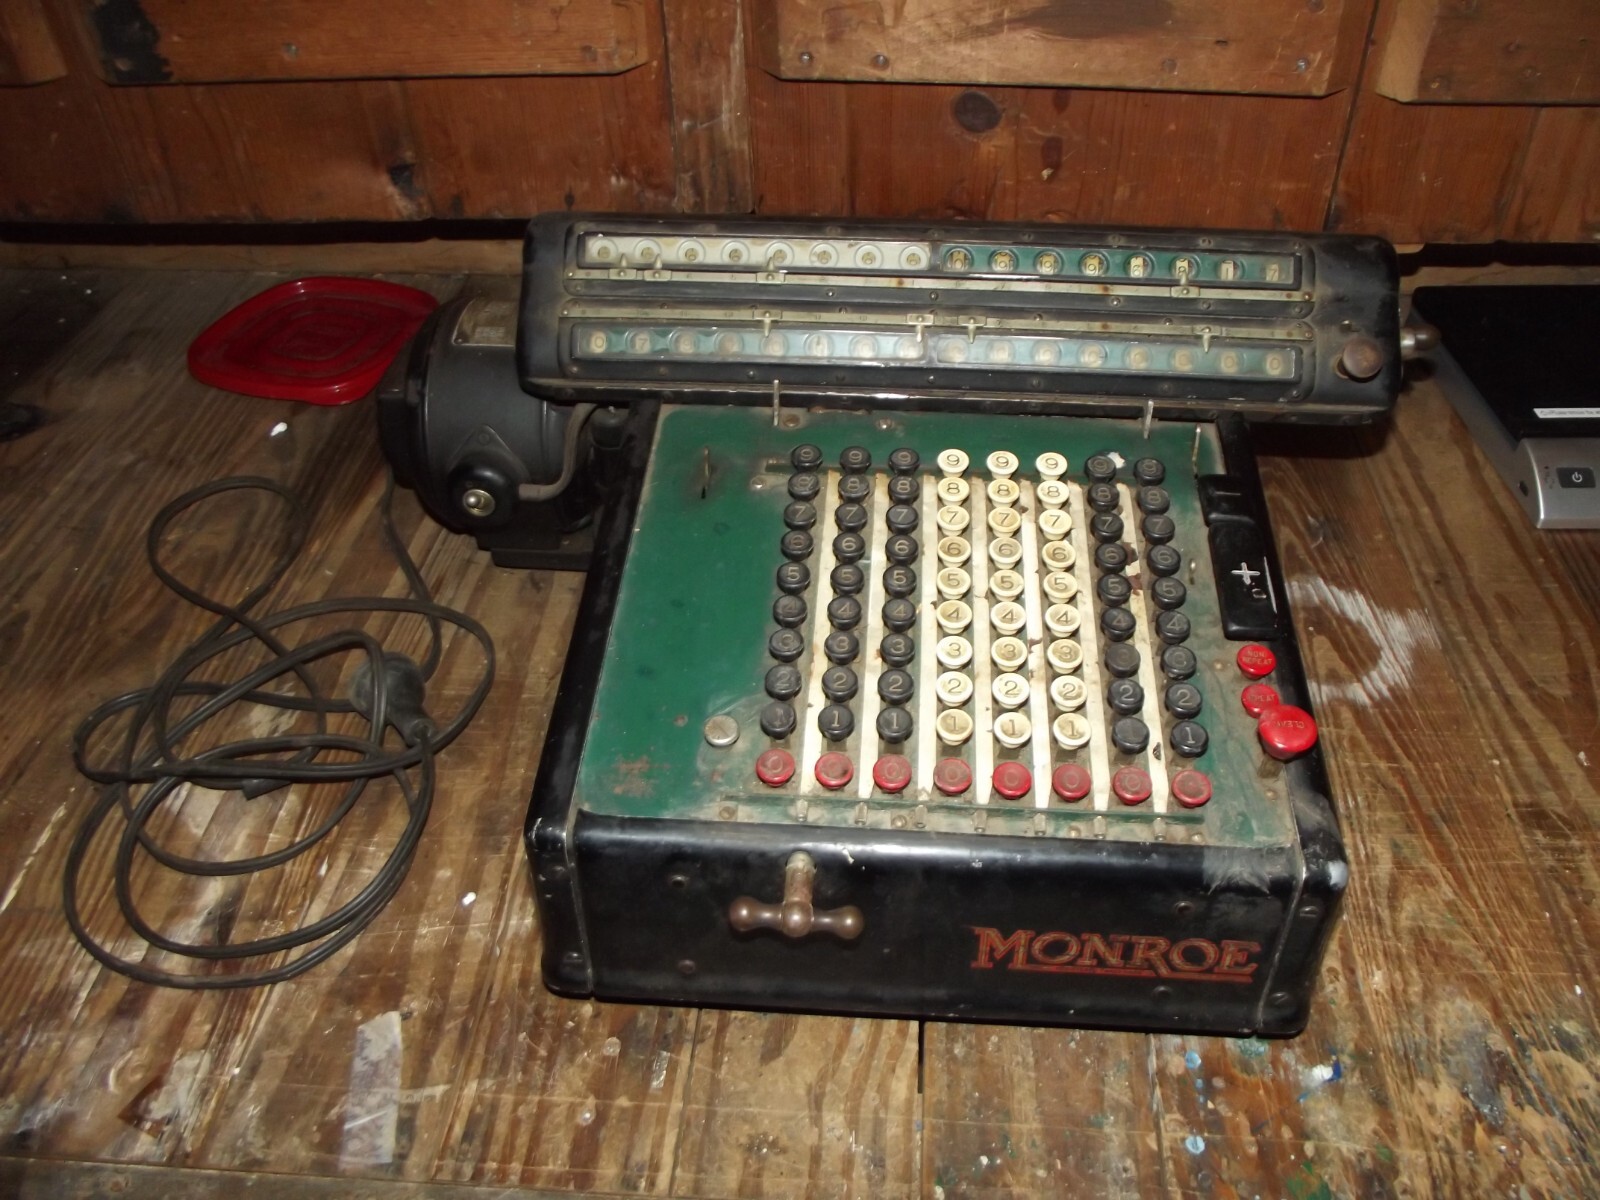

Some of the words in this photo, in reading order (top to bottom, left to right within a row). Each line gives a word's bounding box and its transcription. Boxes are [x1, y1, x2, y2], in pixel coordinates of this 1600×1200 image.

[850, 451, 861, 461] 9
[898, 452, 909, 462] 9
[947, 454, 959, 466] 9
[996, 456, 1009, 467] 9
[1045, 458, 1058, 468] 9
[1093, 460, 1107, 471] 9
[1143, 462, 1156, 474] 9
[847, 479, 859, 489] 8
[897, 481, 909, 492] 8
[947, 483, 960, 495] 8
[998, 484, 1010, 495] 8
[1047, 485, 1060, 497] 8
[1096, 488, 1109, 500] 8
[1148, 491, 1160, 503] 8
[795, 506, 806, 517] 7
[847, 507, 858, 518] 7
[897, 509, 907, 521] 7
[946, 511, 960, 523] 7
[999, 513, 1011, 524] 7
[1050, 515, 1061, 526] 7
[1101, 517, 1113, 529] 7
[1152, 519, 1164, 531] 7
[791, 536, 803, 548] 6
[842, 538, 856, 549] 6
[895, 540, 908, 552] 6
[947, 542, 961, 554] 6
[999, 543, 1013, 555] 6
[1052, 547, 1066, 559] 6
[1105, 550, 1119, 562] 6
[1157, 551, 1171, 563] 6
[787, 568, 800, 581] 5
[841, 570, 853, 582] 5
[893, 571, 906, 583] 5
[947, 574, 960, 586] 5
[1001, 576, 1014, 589] 5
[1054, 578, 1067, 590] 5
[1108, 579, 1121, 592] 5
[1163, 583, 1176, 596] 5
[838, 604, 852, 614] 4
[893, 605, 906, 617] 4
[948, 607, 961, 619] 4
[1002, 610, 1017, 622] 4
[1056, 611, 1071, 624] 4
[1112, 616, 1128, 627] 4
[1167, 618, 1182, 631] 4
[836, 637, 849, 650] 3
[892, 639, 905, 653] 3
[948, 642, 961, 655] 3
[1002, 644, 1016, 658] 3
[1058, 646, 1073, 659] 3
[777, 672, 790, 686] 2
[834, 673, 847, 687] 2
[889, 676, 902, 691] 2
[948, 679, 962, 693] 2
[1004, 681, 1018, 695] 2
[1062, 683, 1075, 697] 2
[1121, 686, 1135, 700] 2
[1178, 690, 1192, 705] 2
[832, 711, 840, 727] 1
[890, 713, 898, 729] 1
[951, 715, 959, 731] 1
[1009, 720, 1017, 735] 1
[1068, 721, 1077, 736] 1
[1185, 727, 1194, 743] 1
[970, 926, 1262, 983] MONROE
